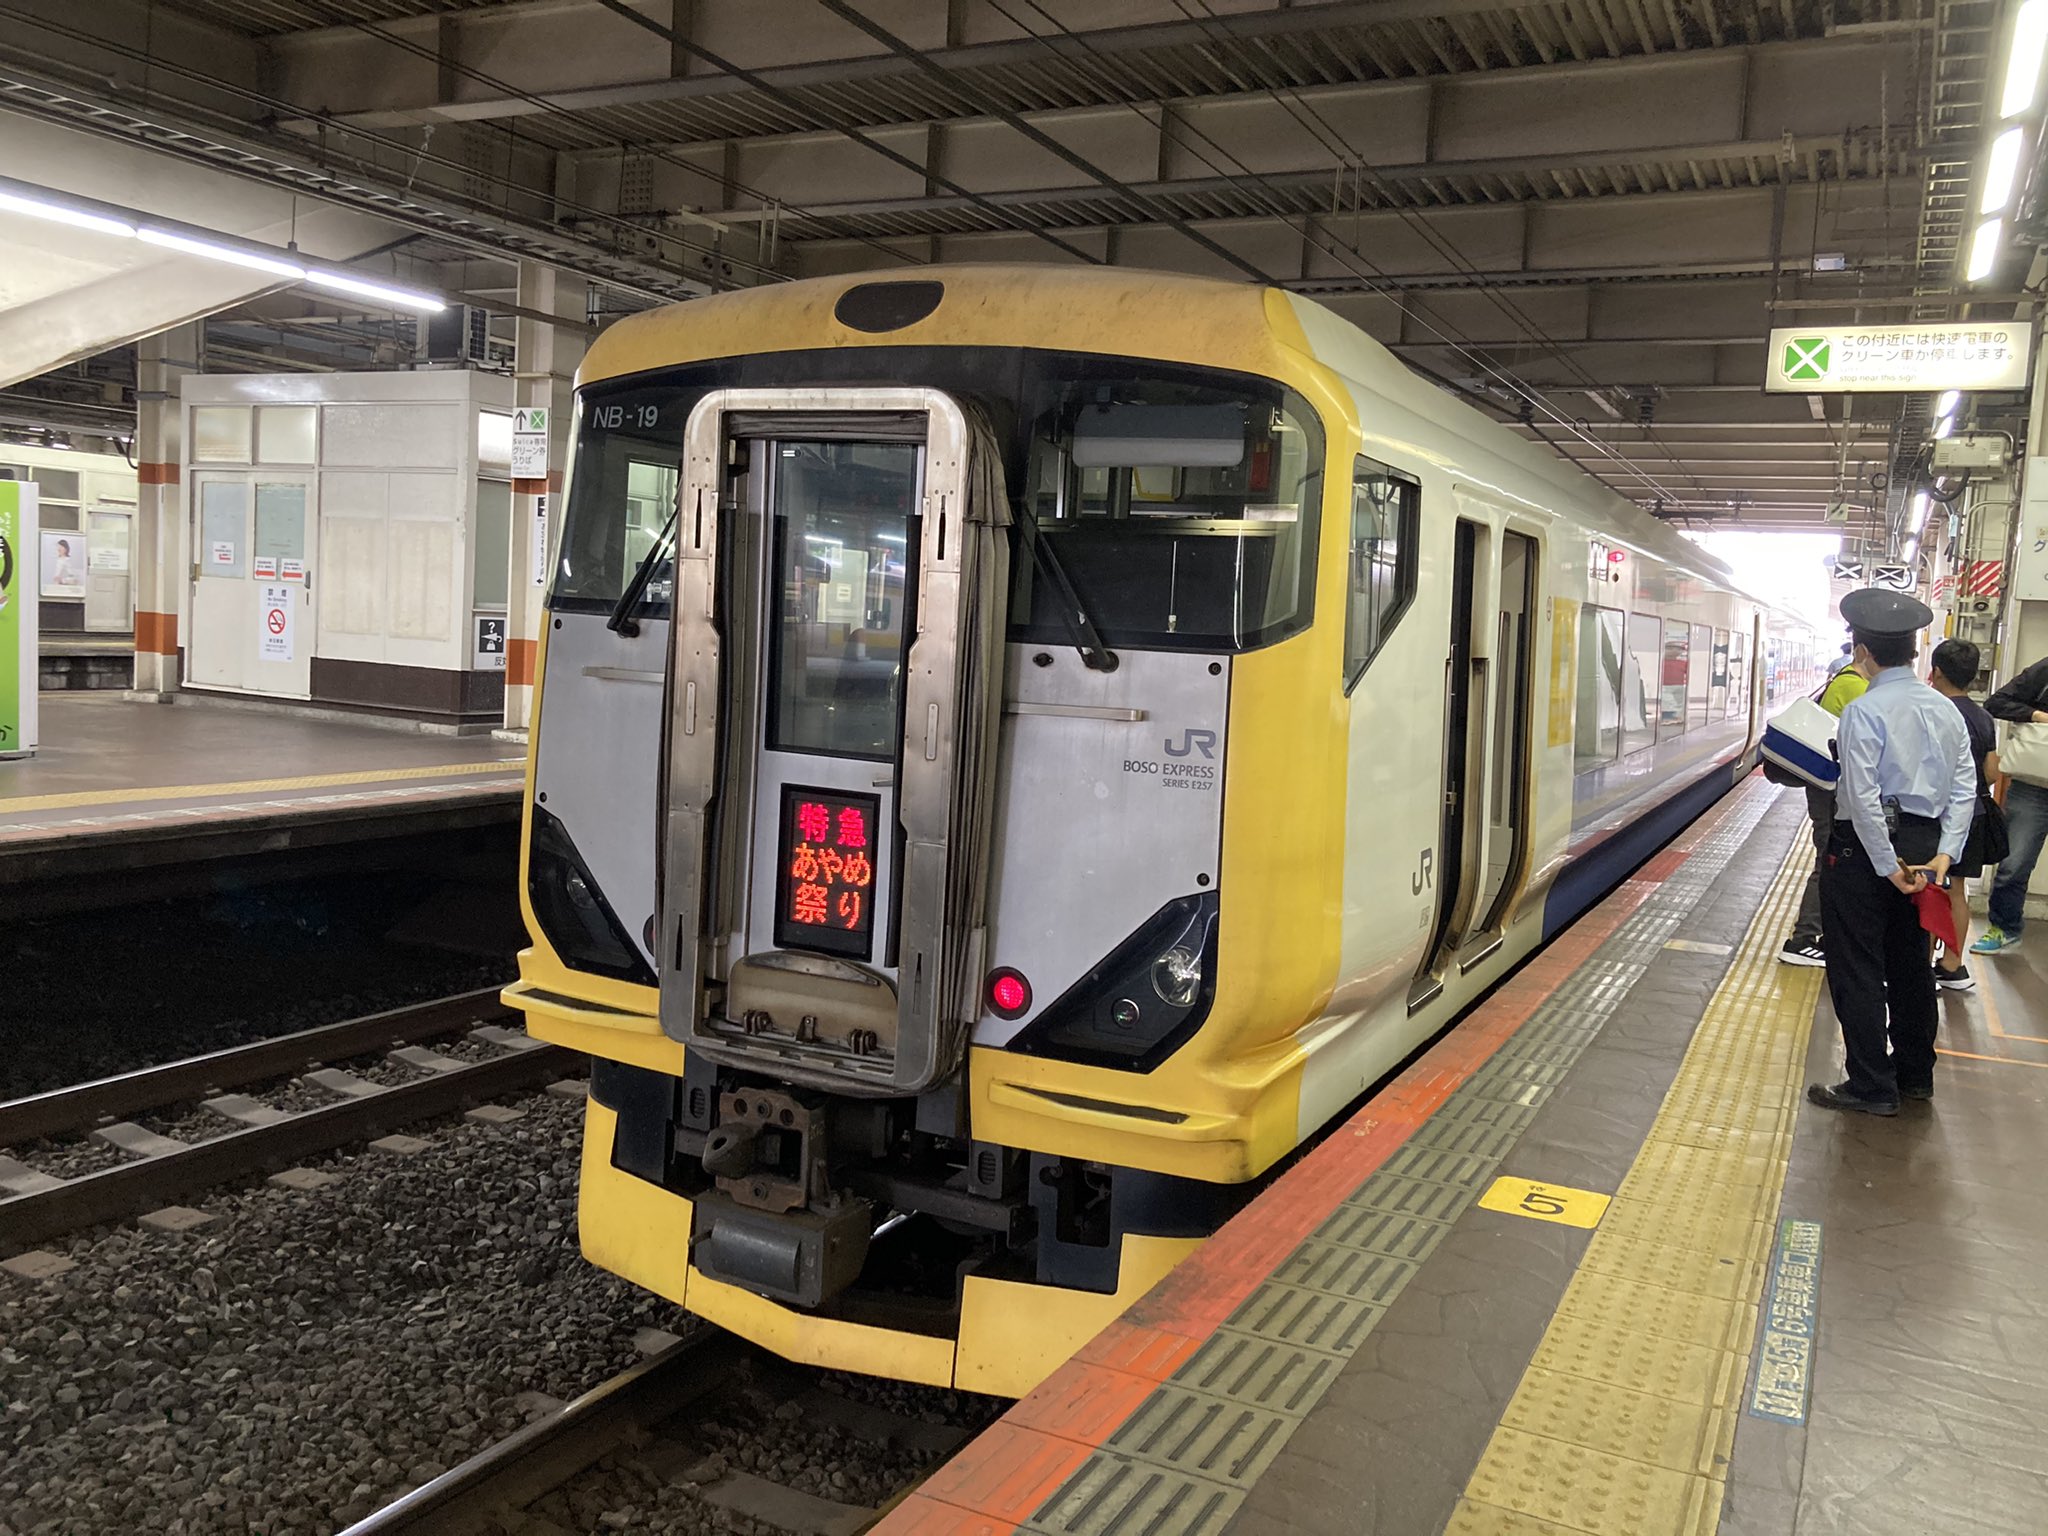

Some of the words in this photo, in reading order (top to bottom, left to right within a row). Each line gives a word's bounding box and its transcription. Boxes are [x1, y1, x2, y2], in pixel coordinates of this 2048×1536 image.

[593, 405, 658, 429] NB-19
[1164, 728, 1216, 759] JR
[1123, 760, 1159, 775] BOSO
[1162, 763, 1214, 779] EXPRESS
[1162, 778, 1189, 789] SERIES
[1192, 781, 1213, 791] E257
[799, 802, 867, 848] 特急
[792, 842, 871, 887] あやめ
[1412, 847, 1433, 896] JR
[794, 883, 861, 928] 祭り
[1520, 1193, 1568, 1215] 5
